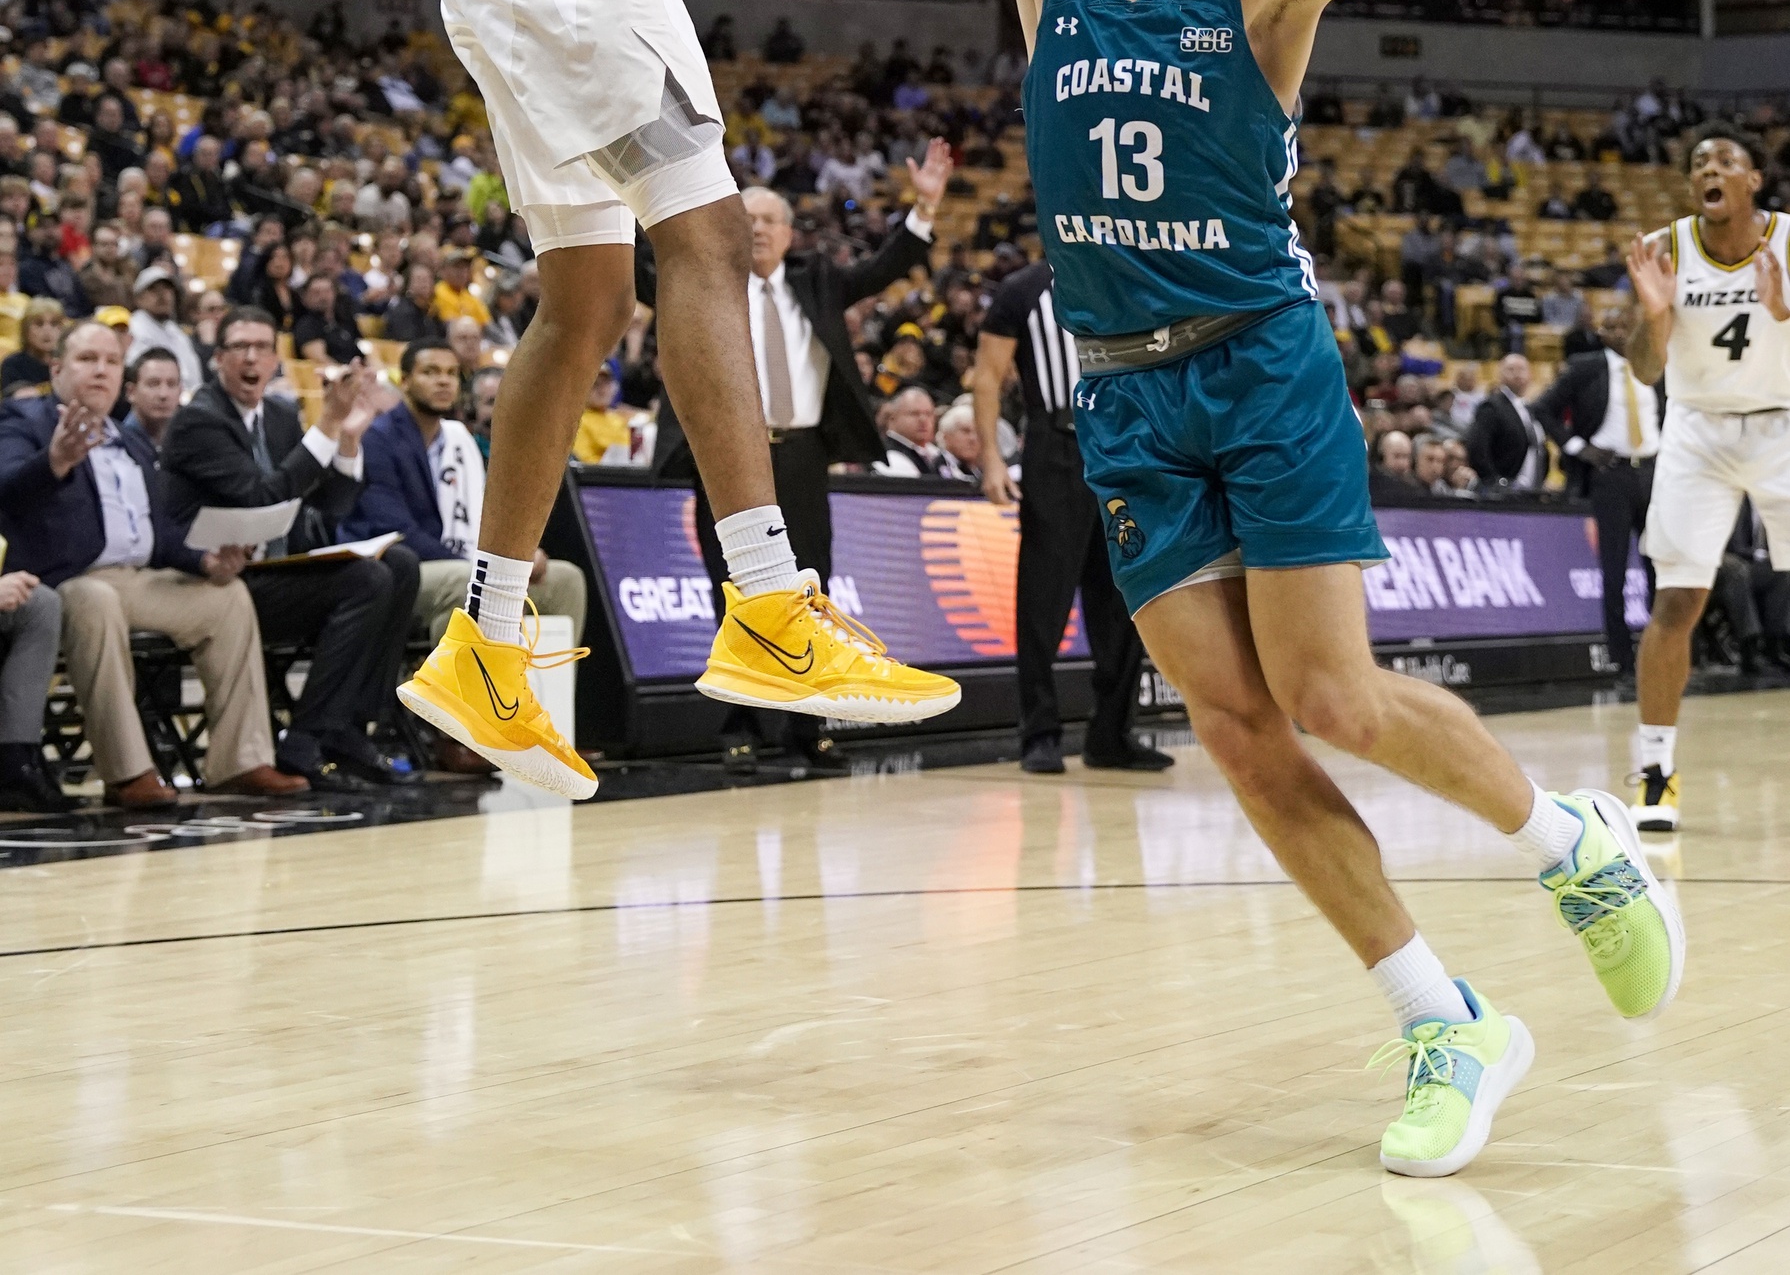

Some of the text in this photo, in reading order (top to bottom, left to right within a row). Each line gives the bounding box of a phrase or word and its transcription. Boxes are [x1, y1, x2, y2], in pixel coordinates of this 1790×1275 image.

[1056, 58, 1210, 112] COASTAL
[1089, 117, 1165, 202] 13
[1054, 214, 1231, 252] CAROLINA
[1684, 290, 1760, 307] MIZZO
[1711, 313, 1750, 361] 4
[1432, 536, 1546, 608] BANK
[619, 576, 716, 623] GREAT
